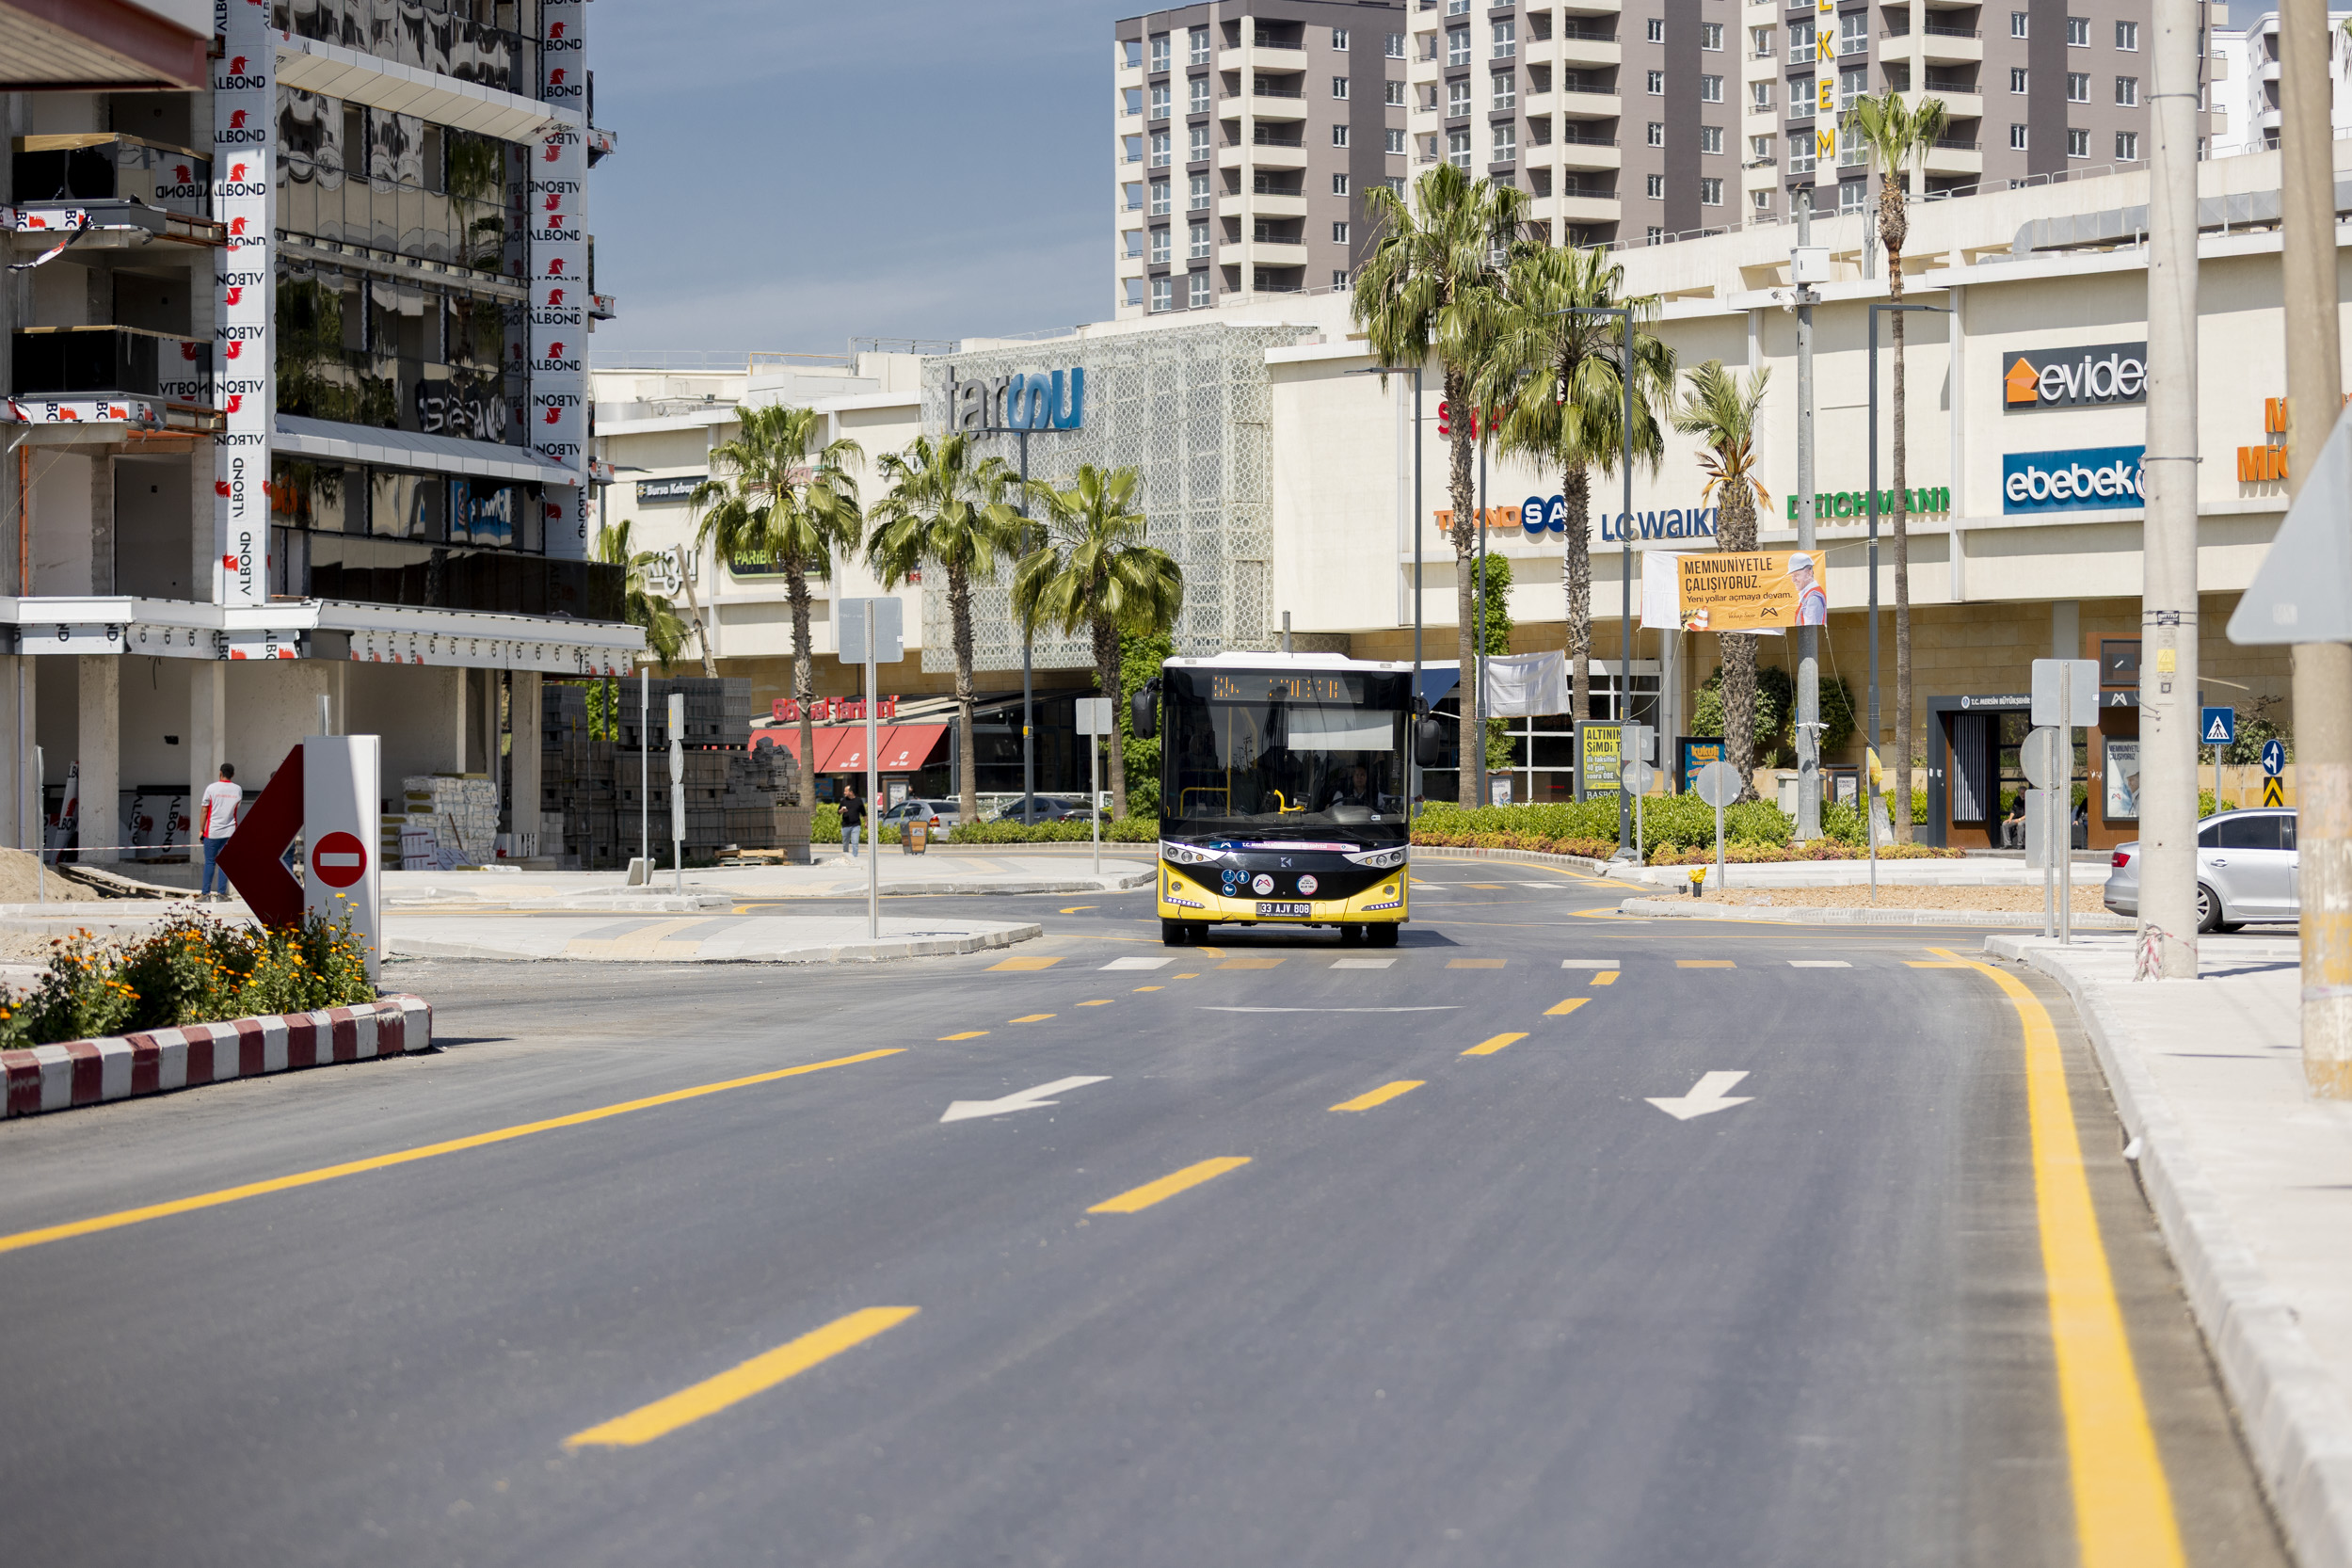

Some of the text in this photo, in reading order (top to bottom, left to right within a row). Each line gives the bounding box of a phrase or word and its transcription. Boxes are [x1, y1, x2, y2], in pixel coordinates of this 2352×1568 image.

[543, 39, 582, 51] BOND
[543, 85, 582, 98] BOND
[216, 273, 264, 286] ALBON
[216, 327, 264, 340] ALBON
[2039, 353, 2147, 401] evide
[216, 380, 264, 394] ALBON
[533, 394, 581, 407] ALBON
[216, 434, 264, 445] ALBON
[533, 443, 581, 456] ALBON
[2006, 460, 2136, 502] ebebek
[232, 457, 245, 519] ALBOND
[647, 485, 669, 496] Bursa
[669, 482, 696, 495] Kebap
[1433, 502, 1566, 530] TKNOSA
[240, 532, 251, 596] ALBOND
[1685, 556, 1773, 575] MEMNUNİYETLE
[1686, 575, 1762, 594] ÇALIŞIYORUZ.
[1687, 591, 1793, 603] Yeni yollar açmaya devam.
[1980, 696, 1998, 705] MERSİN
[830, 695, 900, 720] Tantni
[2109, 744, 2140, 753] MEMNUNİYETL
[1594, 764, 1606, 773] gün
[1261, 904, 1309, 914] 33 AJV 808
